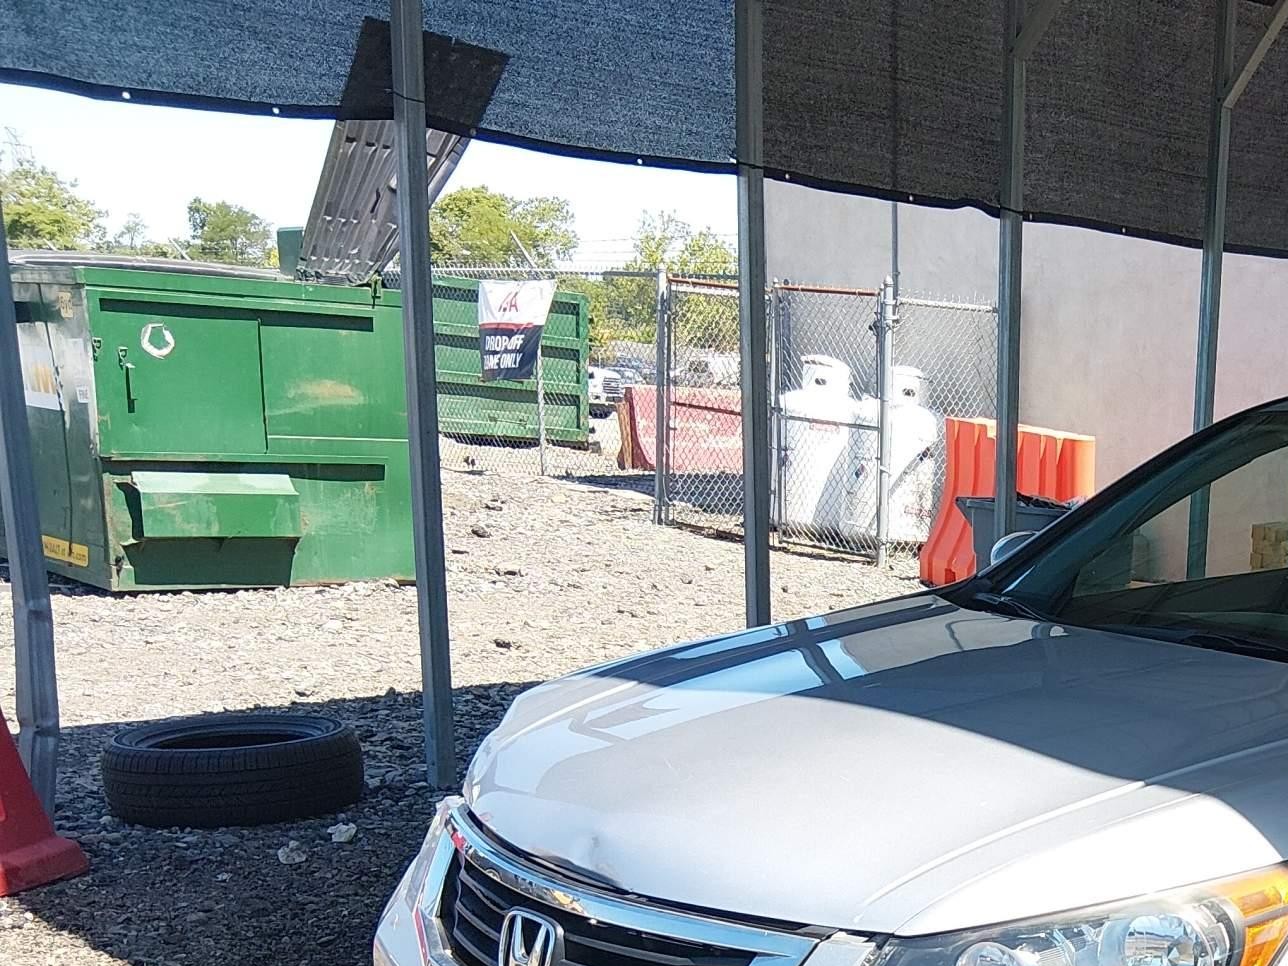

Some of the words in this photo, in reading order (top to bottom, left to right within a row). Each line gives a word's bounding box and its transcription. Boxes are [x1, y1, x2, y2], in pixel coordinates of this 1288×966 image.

[485, 335, 509, 352] DROP
[507, 334, 525, 350] OFF
[500, 352, 523, 369] ONLY
